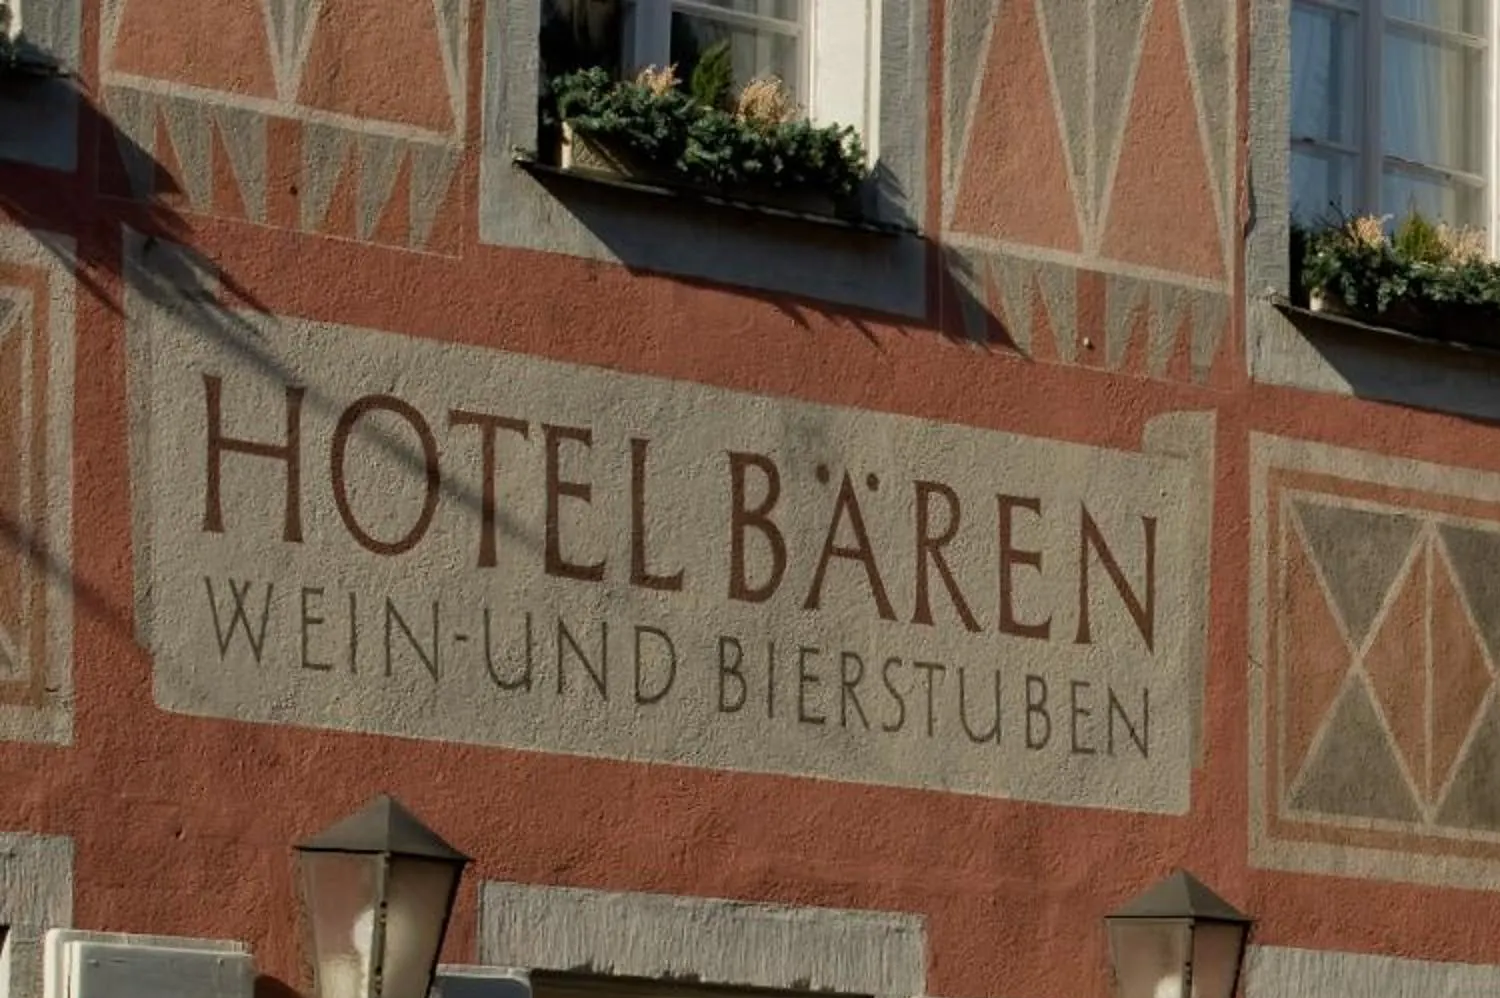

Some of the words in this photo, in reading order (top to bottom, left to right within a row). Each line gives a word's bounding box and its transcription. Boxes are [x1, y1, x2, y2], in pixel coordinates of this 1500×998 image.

[200, 374, 686, 592] HOTEL
[726, 450, 1158, 653] BÄREN
[716, 635, 1150, 759] BIERSTUBEN
